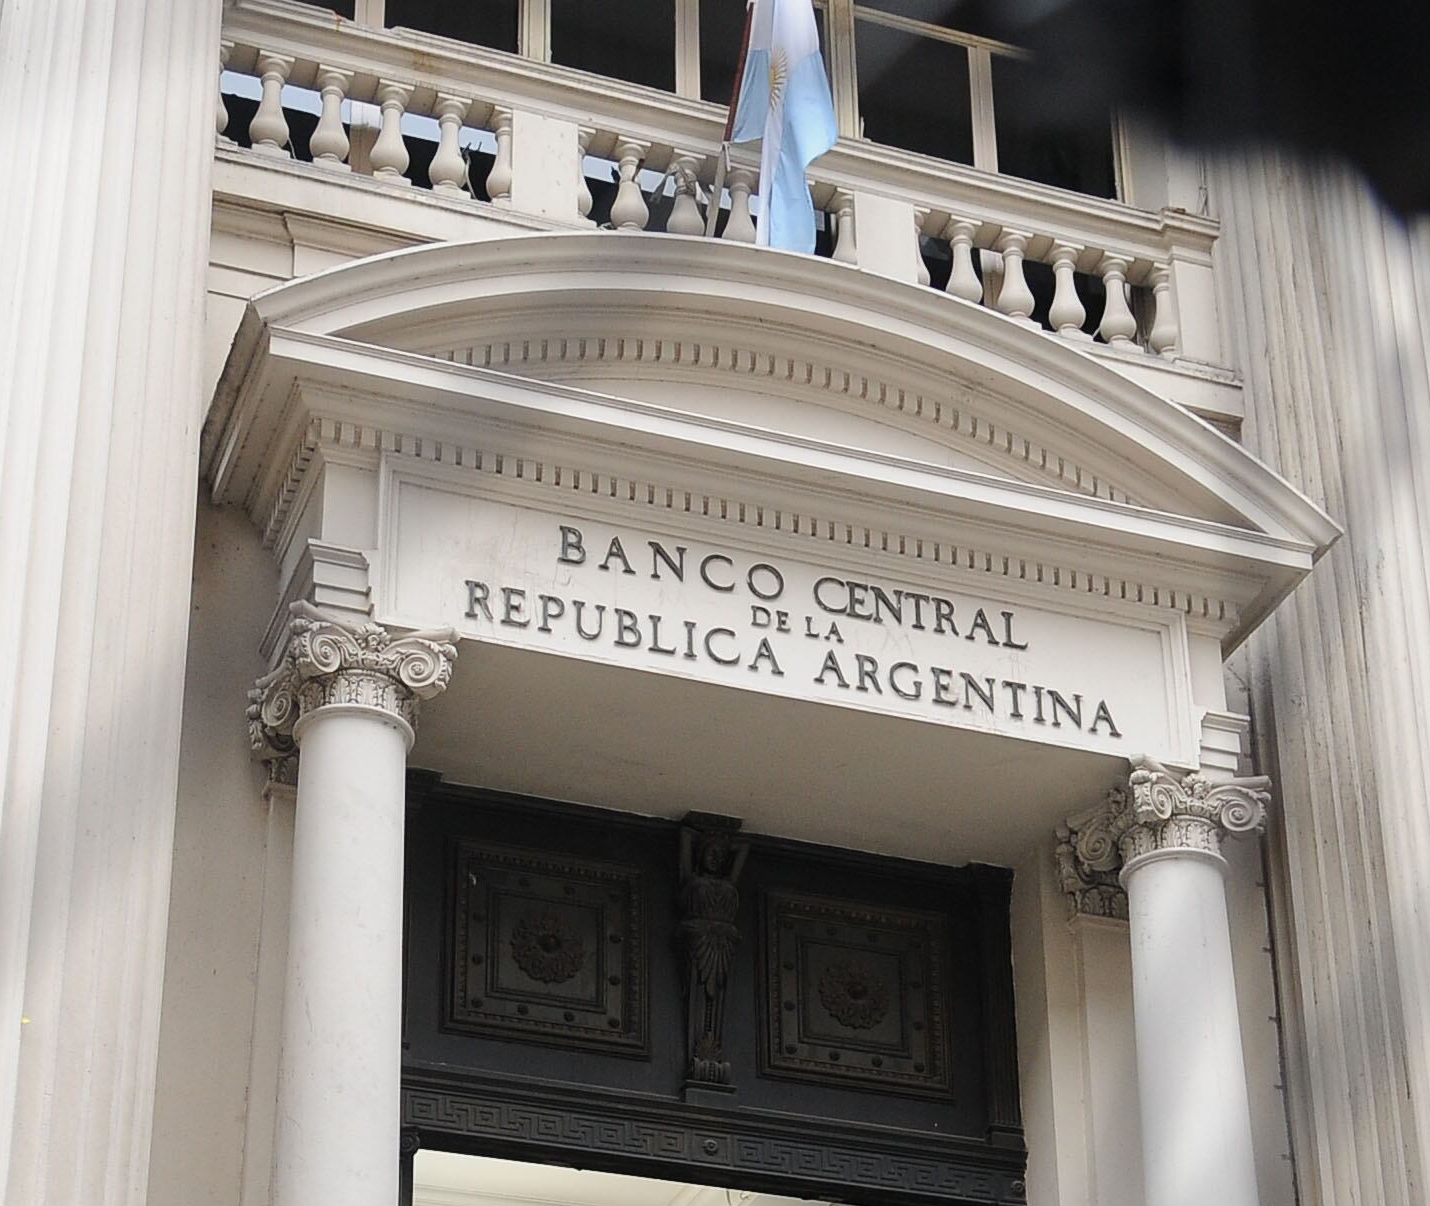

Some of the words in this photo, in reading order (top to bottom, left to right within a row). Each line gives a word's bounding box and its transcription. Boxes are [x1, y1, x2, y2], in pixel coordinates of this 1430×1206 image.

[557, 525, 785, 601] BANCO
[813, 576, 1028, 650] CENTRAL
[751, 605, 791, 633] DE
[804, 616, 844, 643] LA
[464, 580, 784, 676] REPUBLICA
[814, 649, 1123, 739] ARGENTINA
